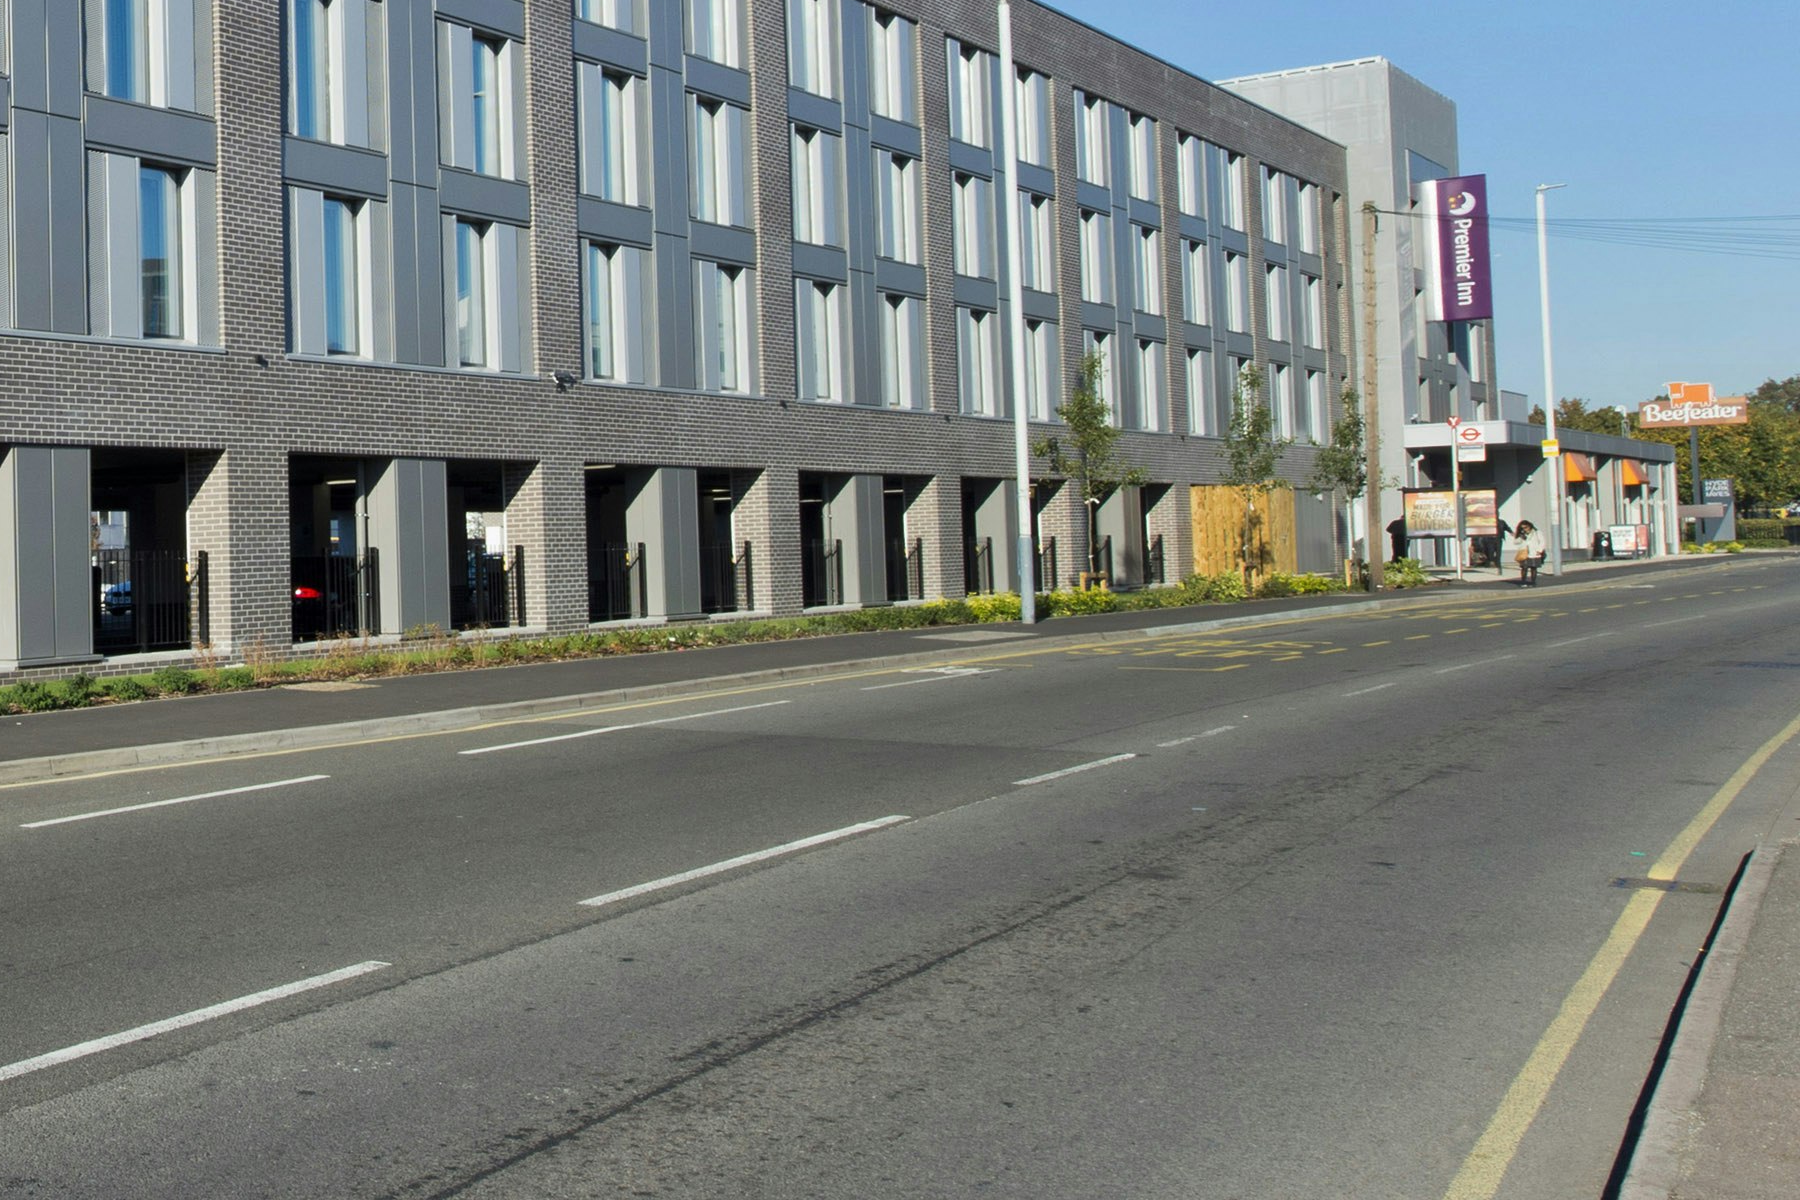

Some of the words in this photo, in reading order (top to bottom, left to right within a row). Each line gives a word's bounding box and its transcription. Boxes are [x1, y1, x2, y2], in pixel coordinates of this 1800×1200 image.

[1454, 218, 1474, 279] Premier
[1457, 281, 1476, 306] Inn
[1448, 416, 1458, 426] Y
[1643, 401, 1742, 424] Beefeater
[1410, 509, 1454, 520] BURGER
